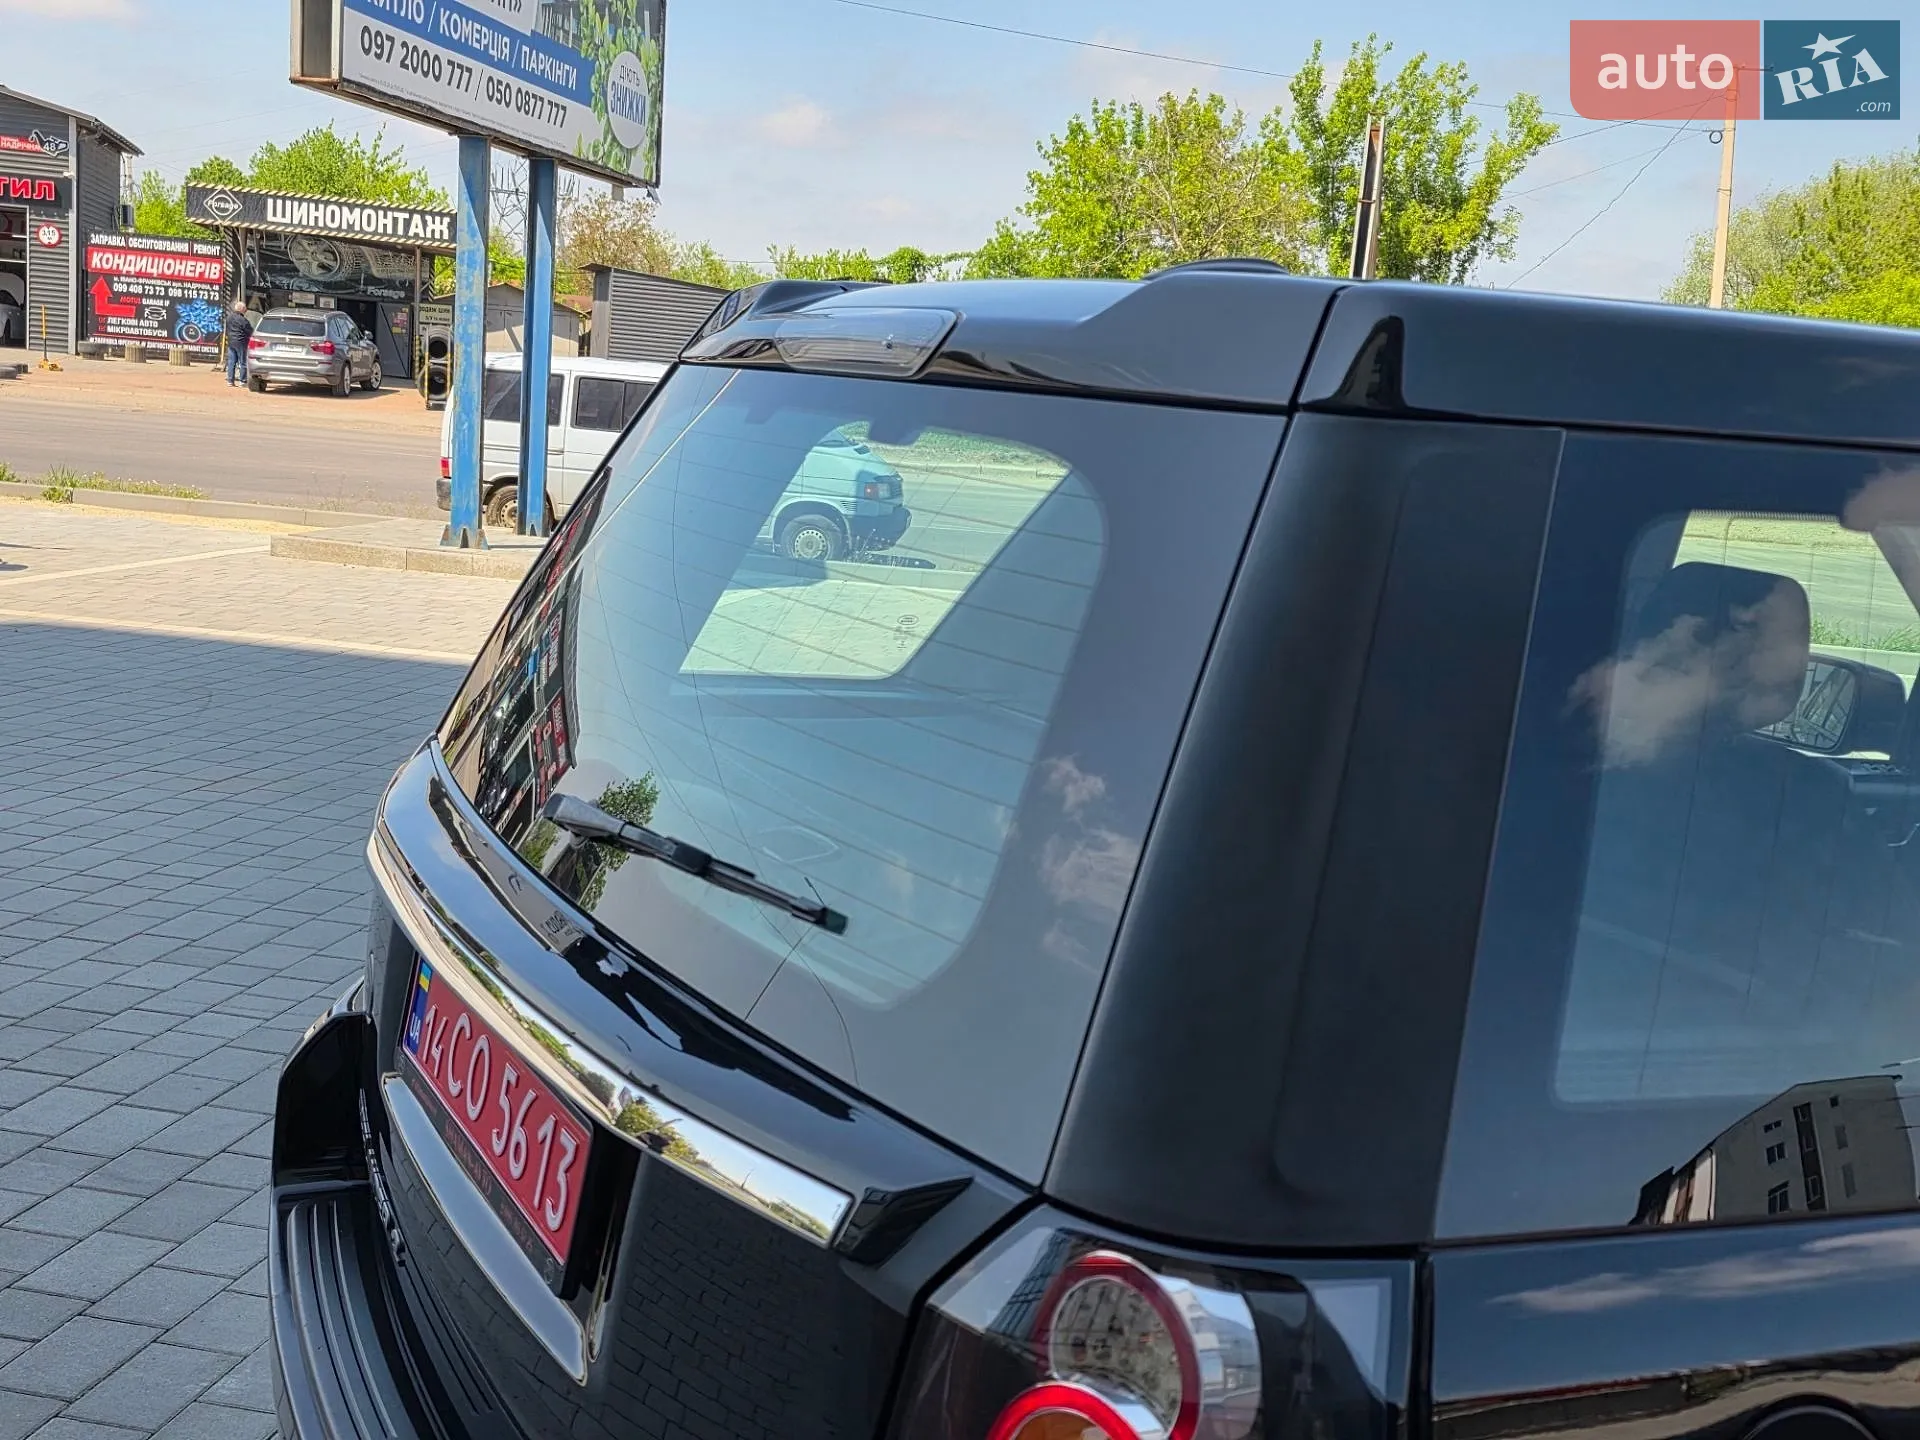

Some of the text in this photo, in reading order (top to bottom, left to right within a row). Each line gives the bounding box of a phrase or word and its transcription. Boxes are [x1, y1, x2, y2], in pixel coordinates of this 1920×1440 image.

[439, 8, 510, 62] КОМЕРЦІЯ
[521, 44, 577, 91] ПАРКІНГИ
[360, 25, 395, 63] 097
[400, 40, 442, 83] 2000
[447, 59, 473, 93] 777
[486, 75, 512, 109] 050
[516, 87, 544, 120] 0877
[548, 100, 567, 128] 777
[610, 81, 647, 126] ЗНИЖКИ
[43, 142, 56, 151] 48
[266, 198, 450, 240] ШИНОМОНТАЖ
[90, 234, 220, 256] ЗАПРАВКА ОБСЛУГОВУВАННЯ РЕМОНТ
[91, 251, 221, 279] КОНДИЦІОНЕРІВ
[113, 283, 219, 300] 099 408 73 73 098 115 73 73
[107, 317, 158, 328] ЛЕГКОВІ АВТО
[107, 326, 168, 337] МІКРОАВТОБУСИ
[409, 1012, 421, 1044] UA
[423, 1004, 448, 1079] 14
[492, 1061, 578, 1232] 5613
